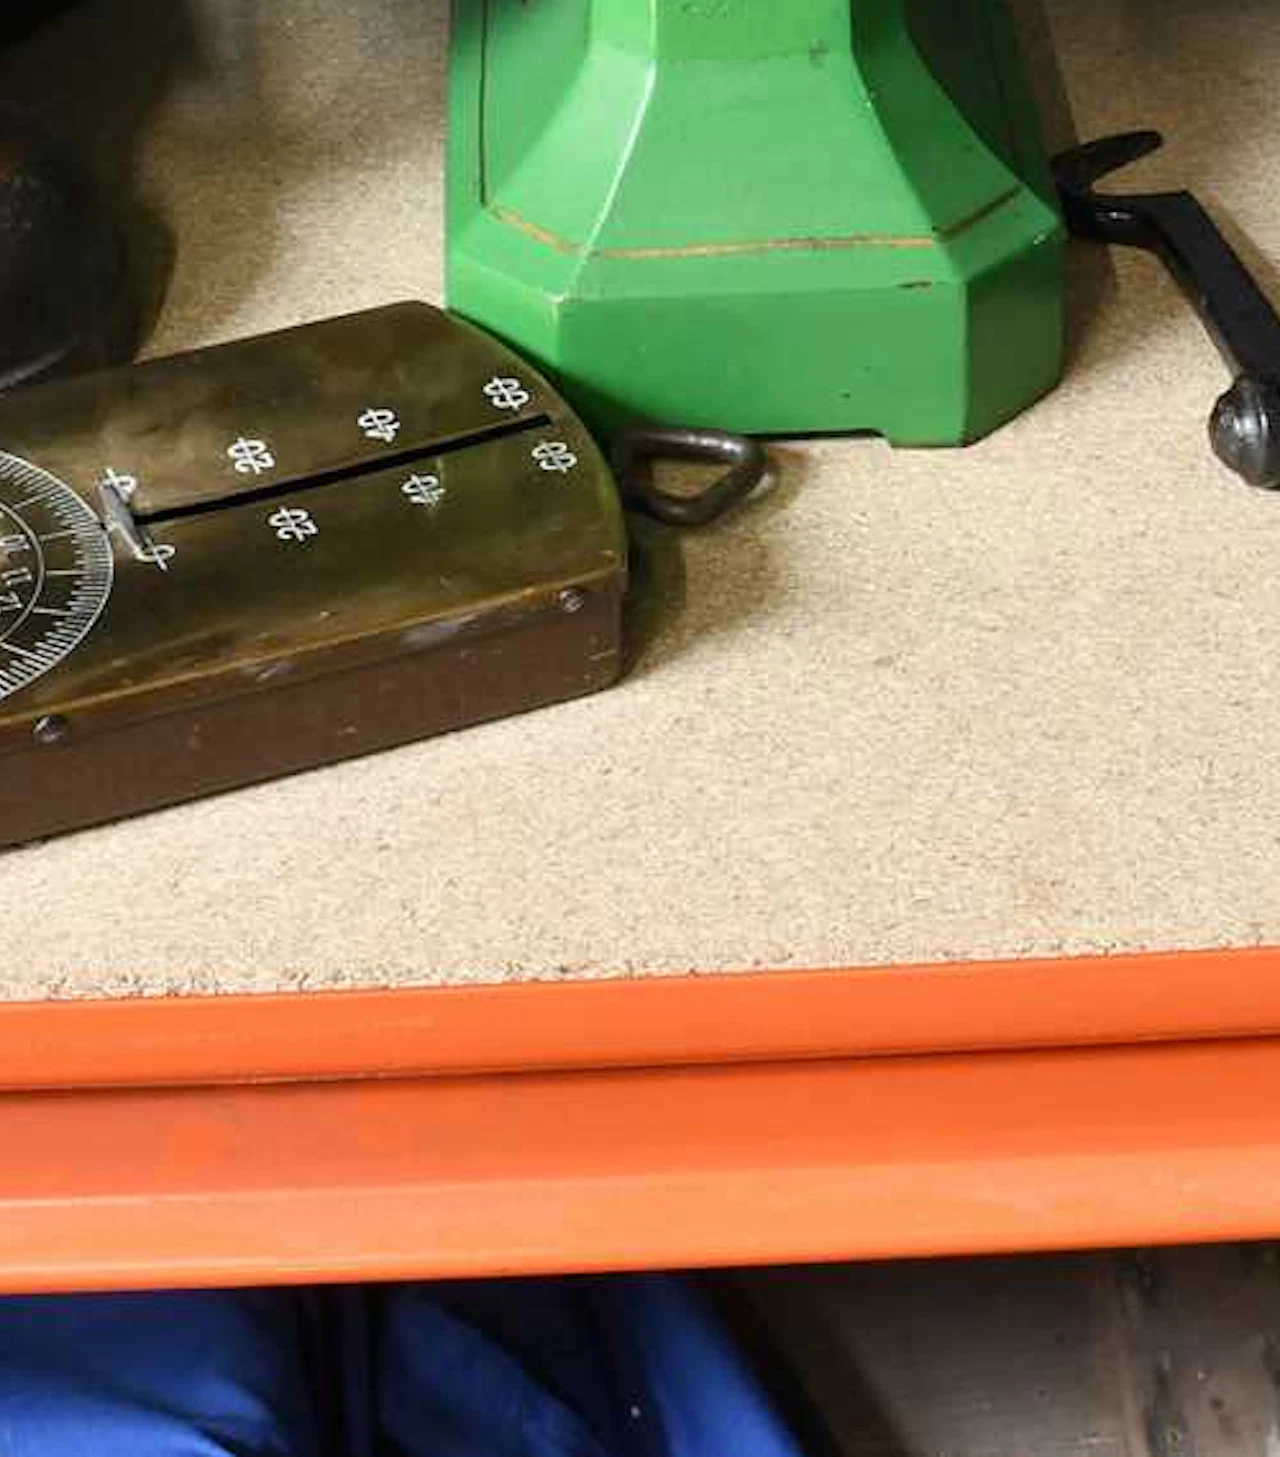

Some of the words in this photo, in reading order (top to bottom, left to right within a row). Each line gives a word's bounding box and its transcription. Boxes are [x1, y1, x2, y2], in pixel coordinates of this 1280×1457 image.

[483, 376, 529, 410] 60
[358, 408, 401, 442] 40
[227, 437, 275, 474] 20
[532, 441, 577, 473] 60
[401, 473, 445, 506] 40
[269, 505, 318, 541] 20
[0, 567, 32, 586] 11
